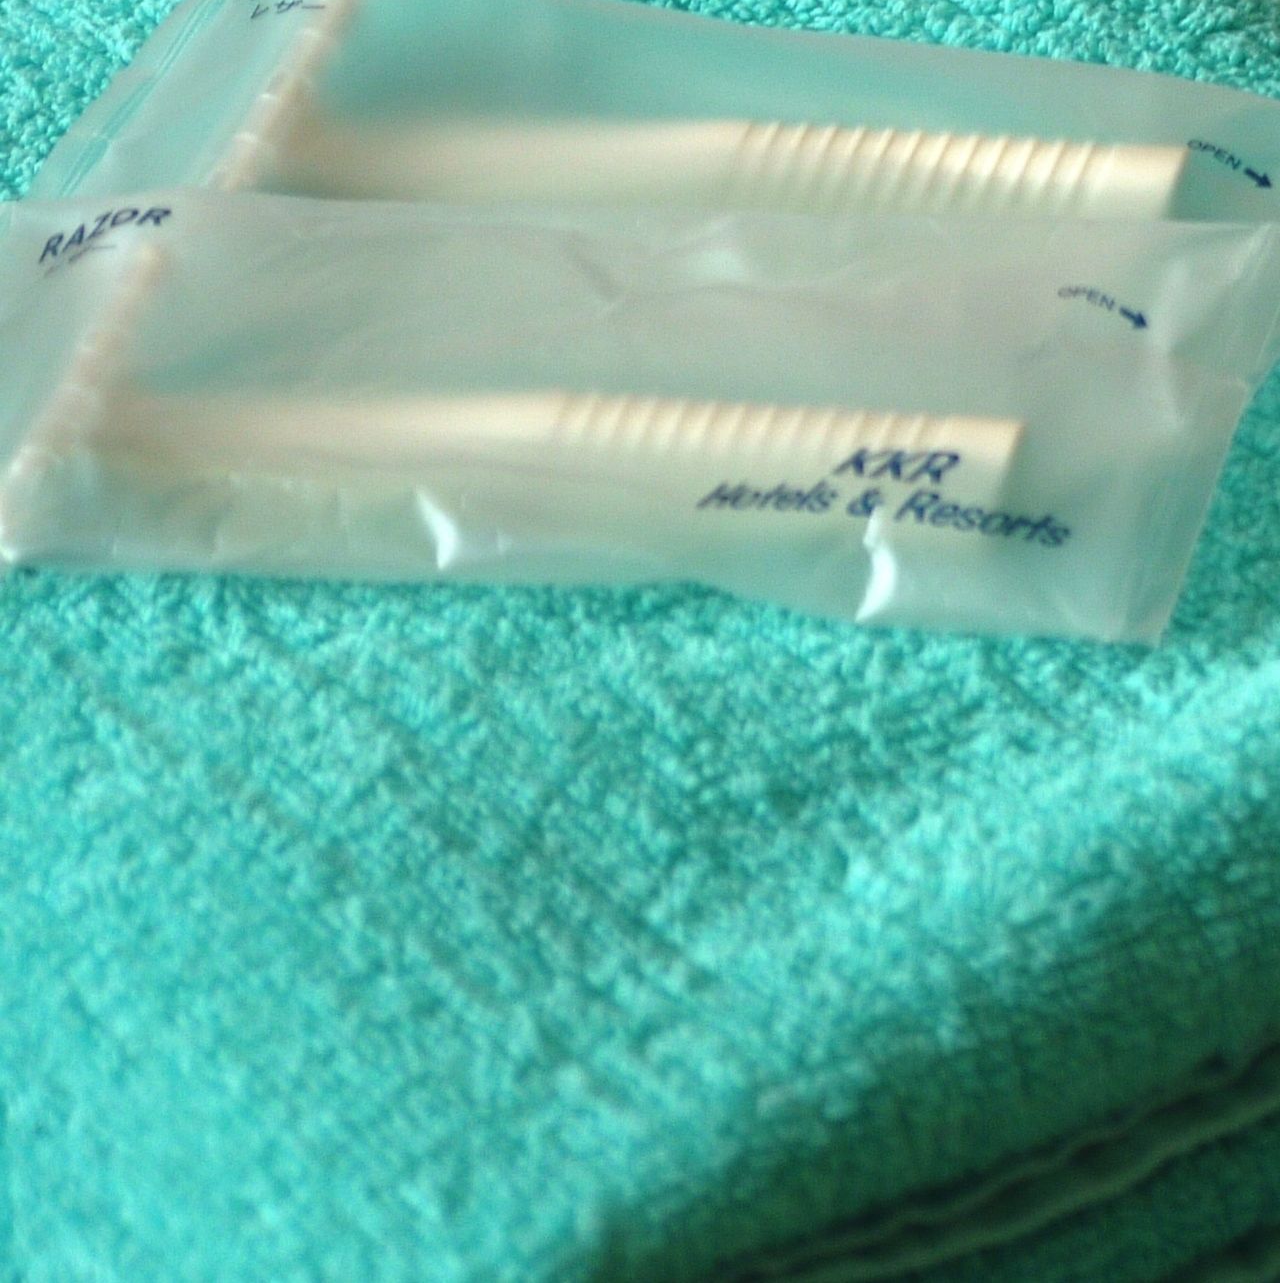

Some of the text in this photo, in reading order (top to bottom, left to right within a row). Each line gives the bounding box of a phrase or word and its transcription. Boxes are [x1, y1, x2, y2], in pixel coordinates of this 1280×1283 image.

[39, 207, 172, 264] RAZOR
[833, 448, 961, 484] KKR
[697, 480, 1072, 548] Hotels & Resorts
